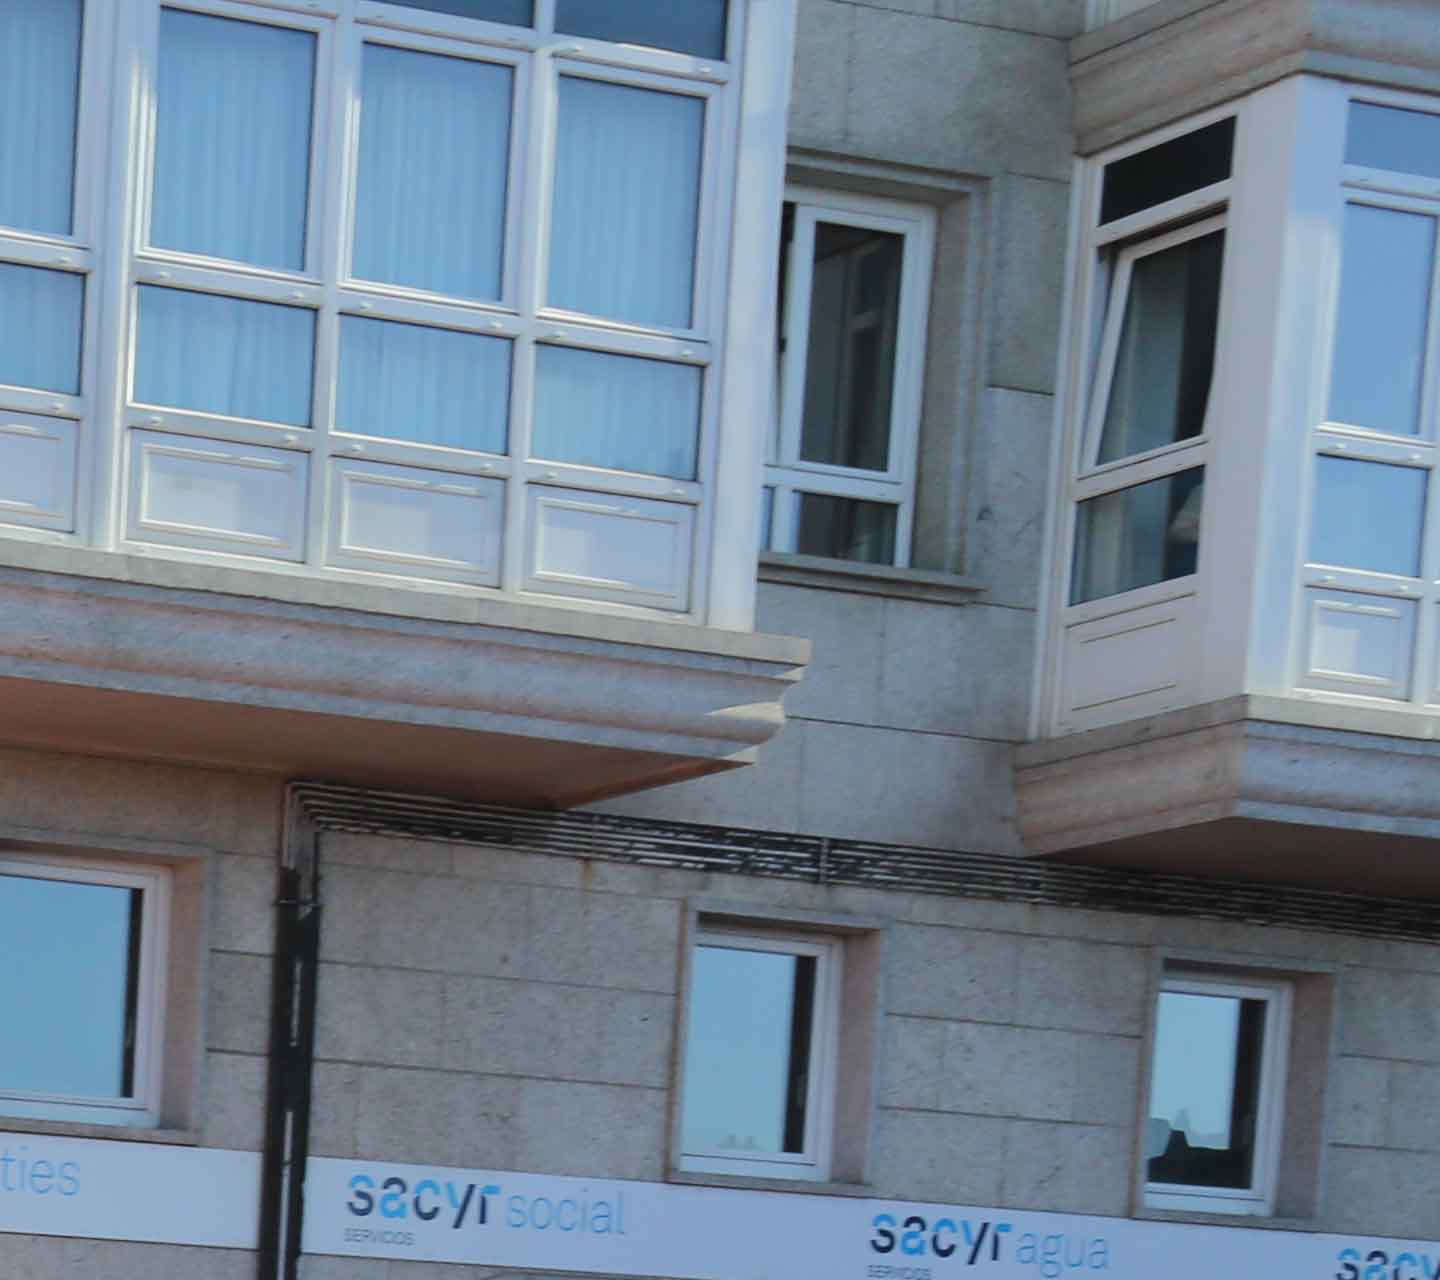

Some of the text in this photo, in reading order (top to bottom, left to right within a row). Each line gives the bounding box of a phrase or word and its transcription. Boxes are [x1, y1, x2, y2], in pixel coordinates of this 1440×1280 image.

[347, 1174, 626, 1235] sacyr social
[870, 1213, 1111, 1279] sacyr agua
